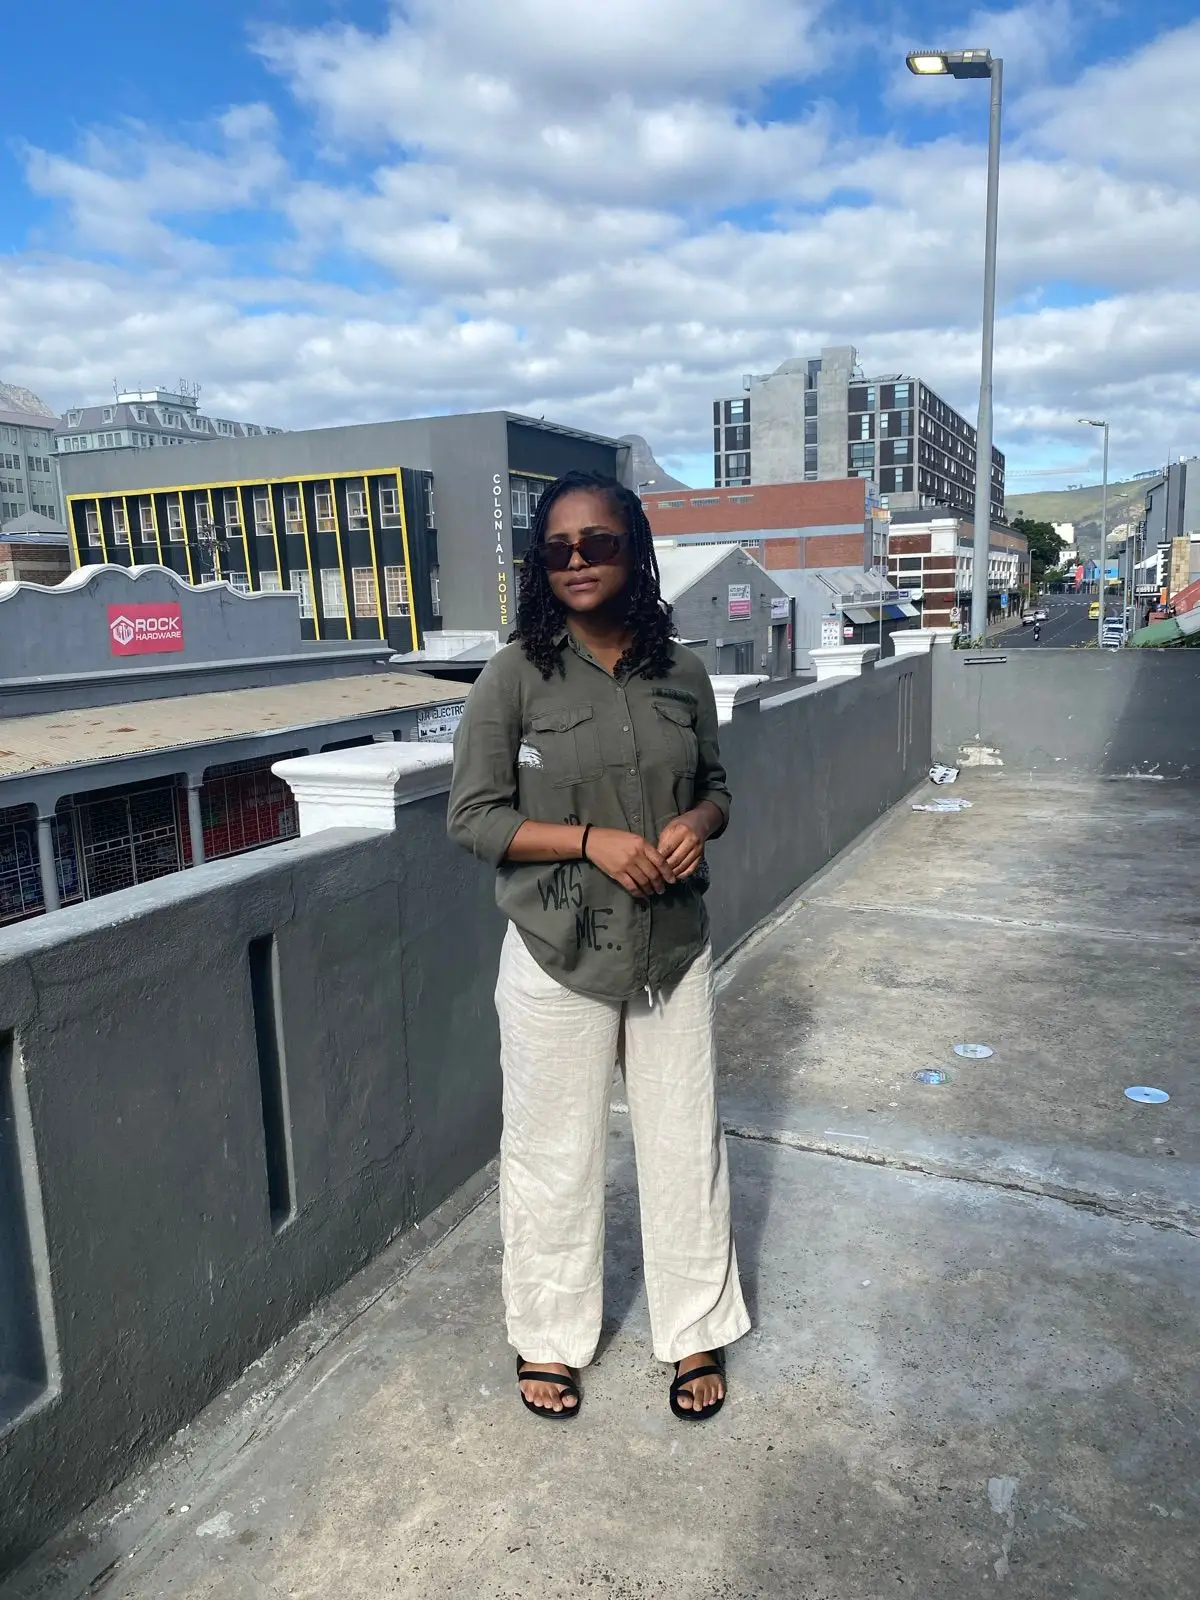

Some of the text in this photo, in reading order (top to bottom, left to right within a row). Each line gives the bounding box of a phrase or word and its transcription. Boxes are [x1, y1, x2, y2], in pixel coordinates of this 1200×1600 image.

[493, 474, 508, 625] COLONIAL HOUSE
[136, 617, 179, 632] ROCK
[136, 631, 181, 640] HARDWARE
[537, 861, 583, 911] WAS
